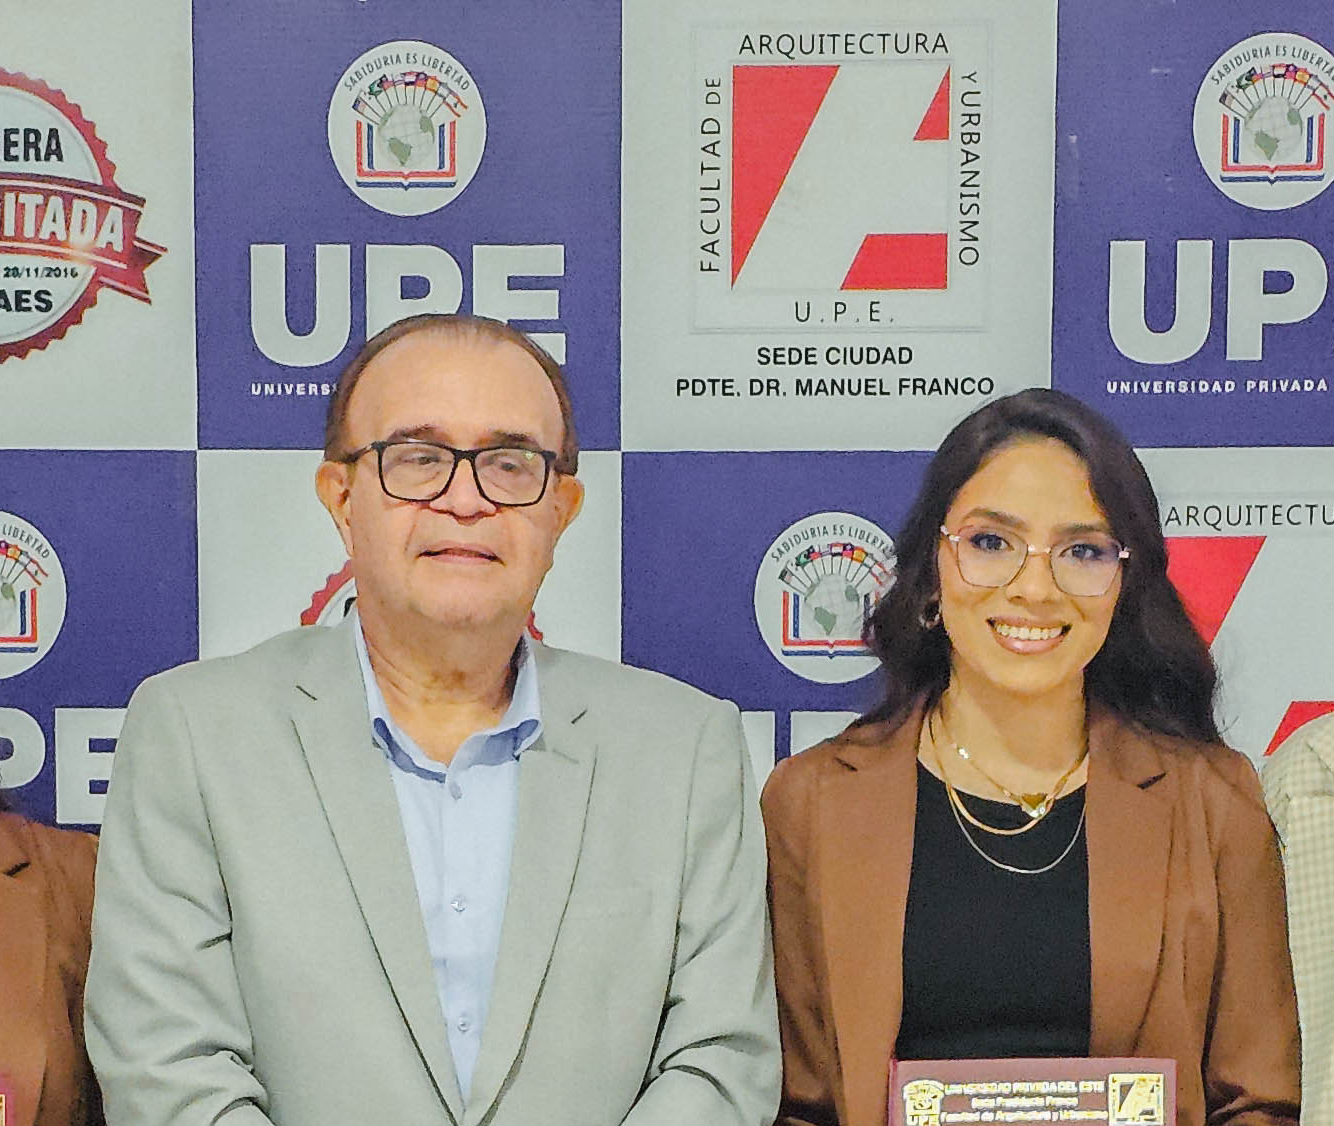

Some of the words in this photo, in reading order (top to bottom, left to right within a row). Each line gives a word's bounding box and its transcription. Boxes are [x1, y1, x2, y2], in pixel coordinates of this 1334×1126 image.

[739, 33, 949, 58] ARQUITECTURA
[344, 53, 402, 91] SABIDURIA
[406, 53, 417, 64] ES
[421, 54, 471, 91] LIBERTAD
[1211, 48, 1271, 85] SABIDURIA
[1275, 45, 1287, 57] ES
[705, 76, 720, 106] DE
[701, 114, 720, 273] FACULTAD
[959, 90, 979, 267] URBANISMO
[250, 243, 566, 367] UPE
[757, 346, 818, 366] SEDE
[824, 346, 913, 366] CIUDAD
[250, 382, 335, 396] UNIVERS
[676, 378, 741, 397] PDTE.
[748, 378, 787, 397] DR.
[795, 377, 890, 397] MANUEL
[897, 376, 995, 397] FRANCO
[1107, 380, 1236, 393] UNIVERSIDAD
[1246, 379, 1328, 392] PRIVADA
[2, 523, 50, 559] LIBERTAD
[771, 526, 829, 562] SABIDURIA
[833, 525, 844, 535] ES
[848, 526, 887, 550] LIBERT
